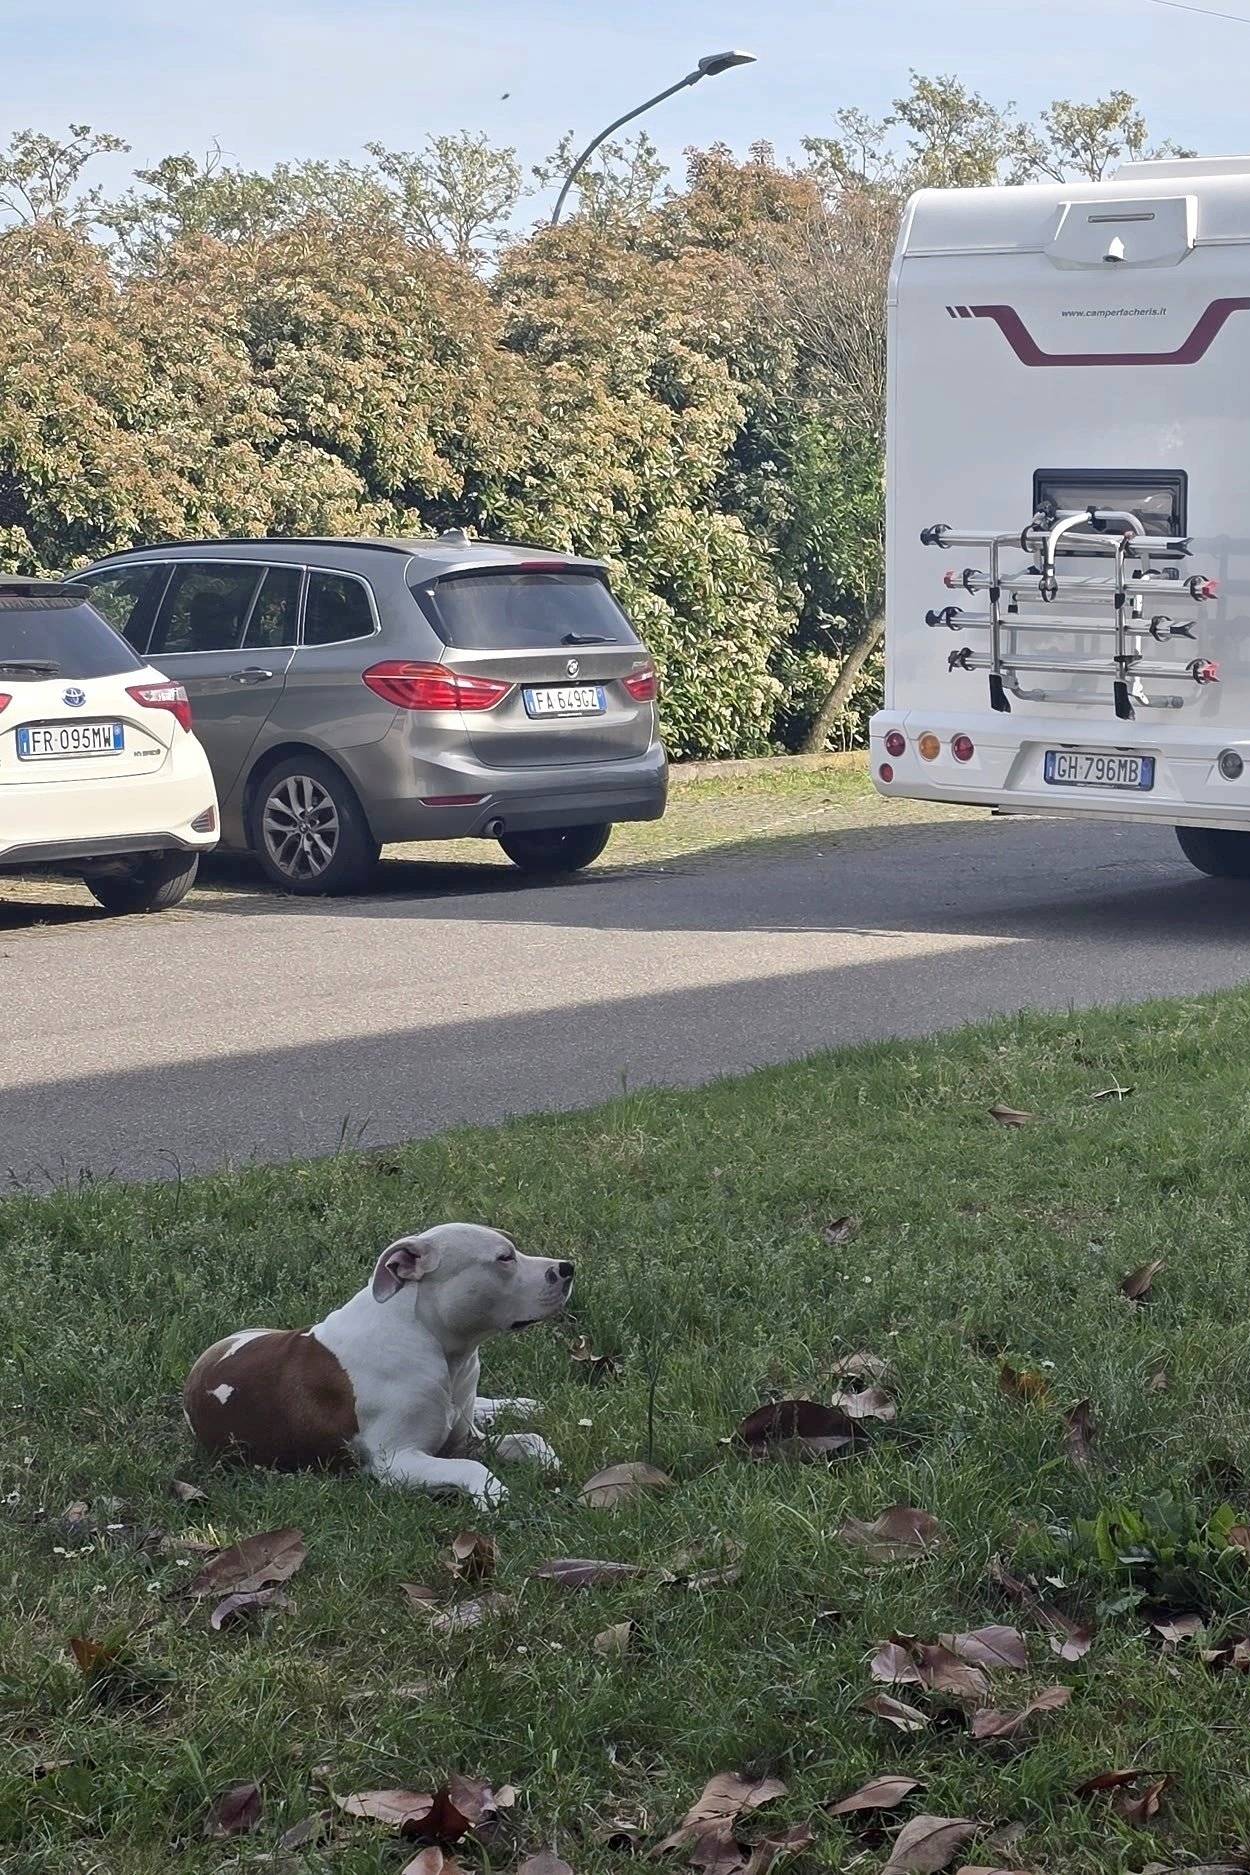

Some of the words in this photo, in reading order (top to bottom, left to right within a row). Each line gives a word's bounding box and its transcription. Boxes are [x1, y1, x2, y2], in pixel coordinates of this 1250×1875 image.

[536, 691, 554, 710] FA
[558, 689, 598, 709] 649GZ
[32, 730, 54, 752] FR
[60, 727, 111, 750] 095MW
[1058, 755, 1078, 779] GH
[1084, 757, 1139, 782] 796MB
